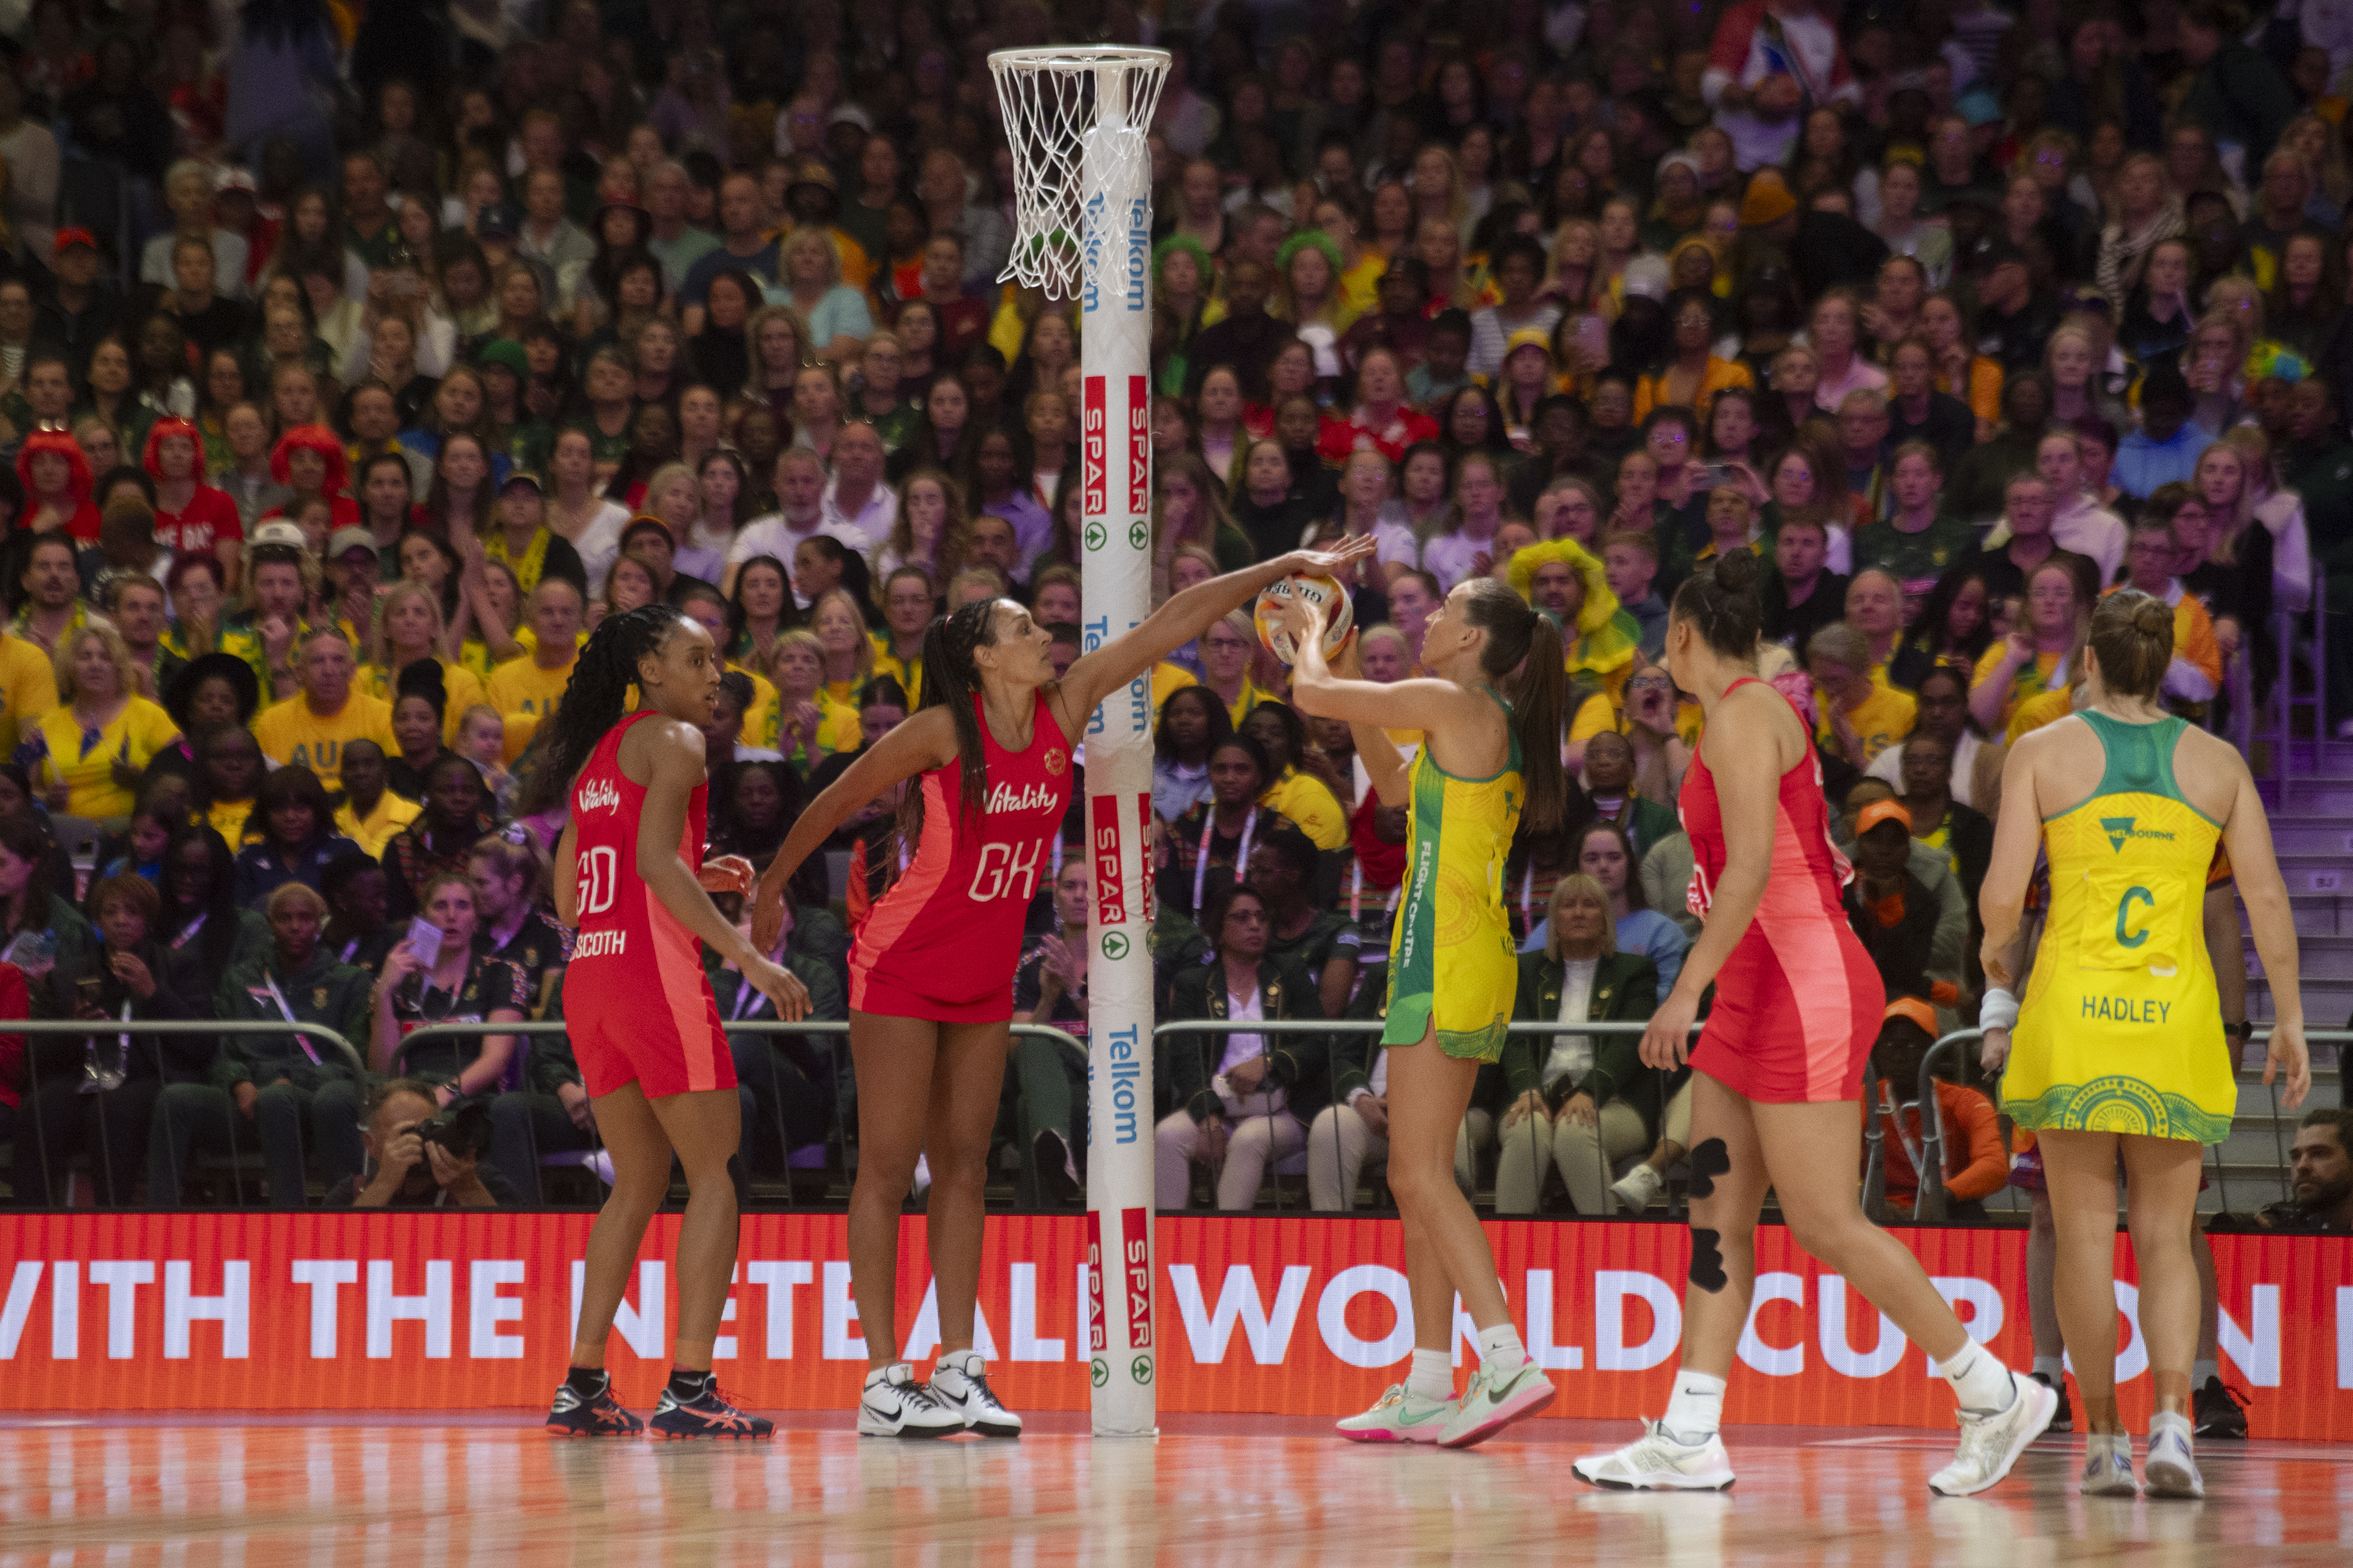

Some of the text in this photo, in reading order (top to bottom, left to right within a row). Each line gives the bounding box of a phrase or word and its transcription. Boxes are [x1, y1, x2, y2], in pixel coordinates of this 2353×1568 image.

[1127, 193, 1147, 311] Telkom
[1086, 407, 1103, 513] SPAR
[1132, 407, 1147, 513] SPAR
[579, 779, 620, 816] Vitality
[983, 781, 1058, 815] Vitality
[968, 838, 1043, 902] GK
[1097, 827, 1122, 923] SPAR
[1413, 841, 1431, 901] FLIGHT
[2116, 885, 2155, 948] C
[2082, 993, 2171, 1024] HADLEY
[1109, 1024, 1141, 1144] Telkom
[292, 1260, 525, 1358] THE
[1128, 1239, 1149, 1346] SPAR
